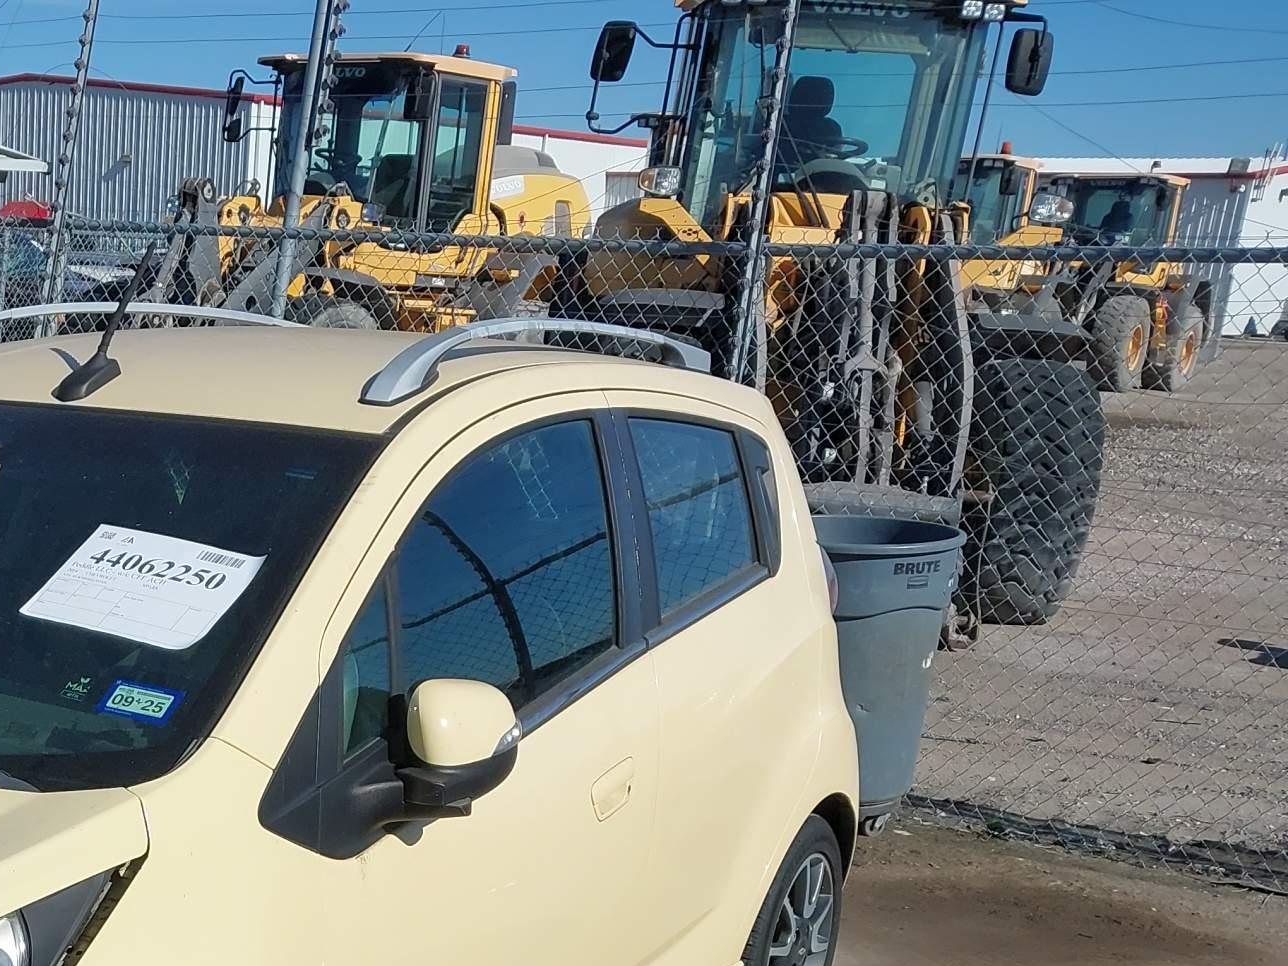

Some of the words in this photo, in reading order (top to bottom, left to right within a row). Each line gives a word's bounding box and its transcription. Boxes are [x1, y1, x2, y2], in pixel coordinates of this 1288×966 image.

[335, 66, 366, 78] LVO
[89, 548, 227, 590] 44062250
[893, 559, 941, 576] BRUTE
[111, 693, 135, 707] 09
[141, 699, 166, 714] 25
